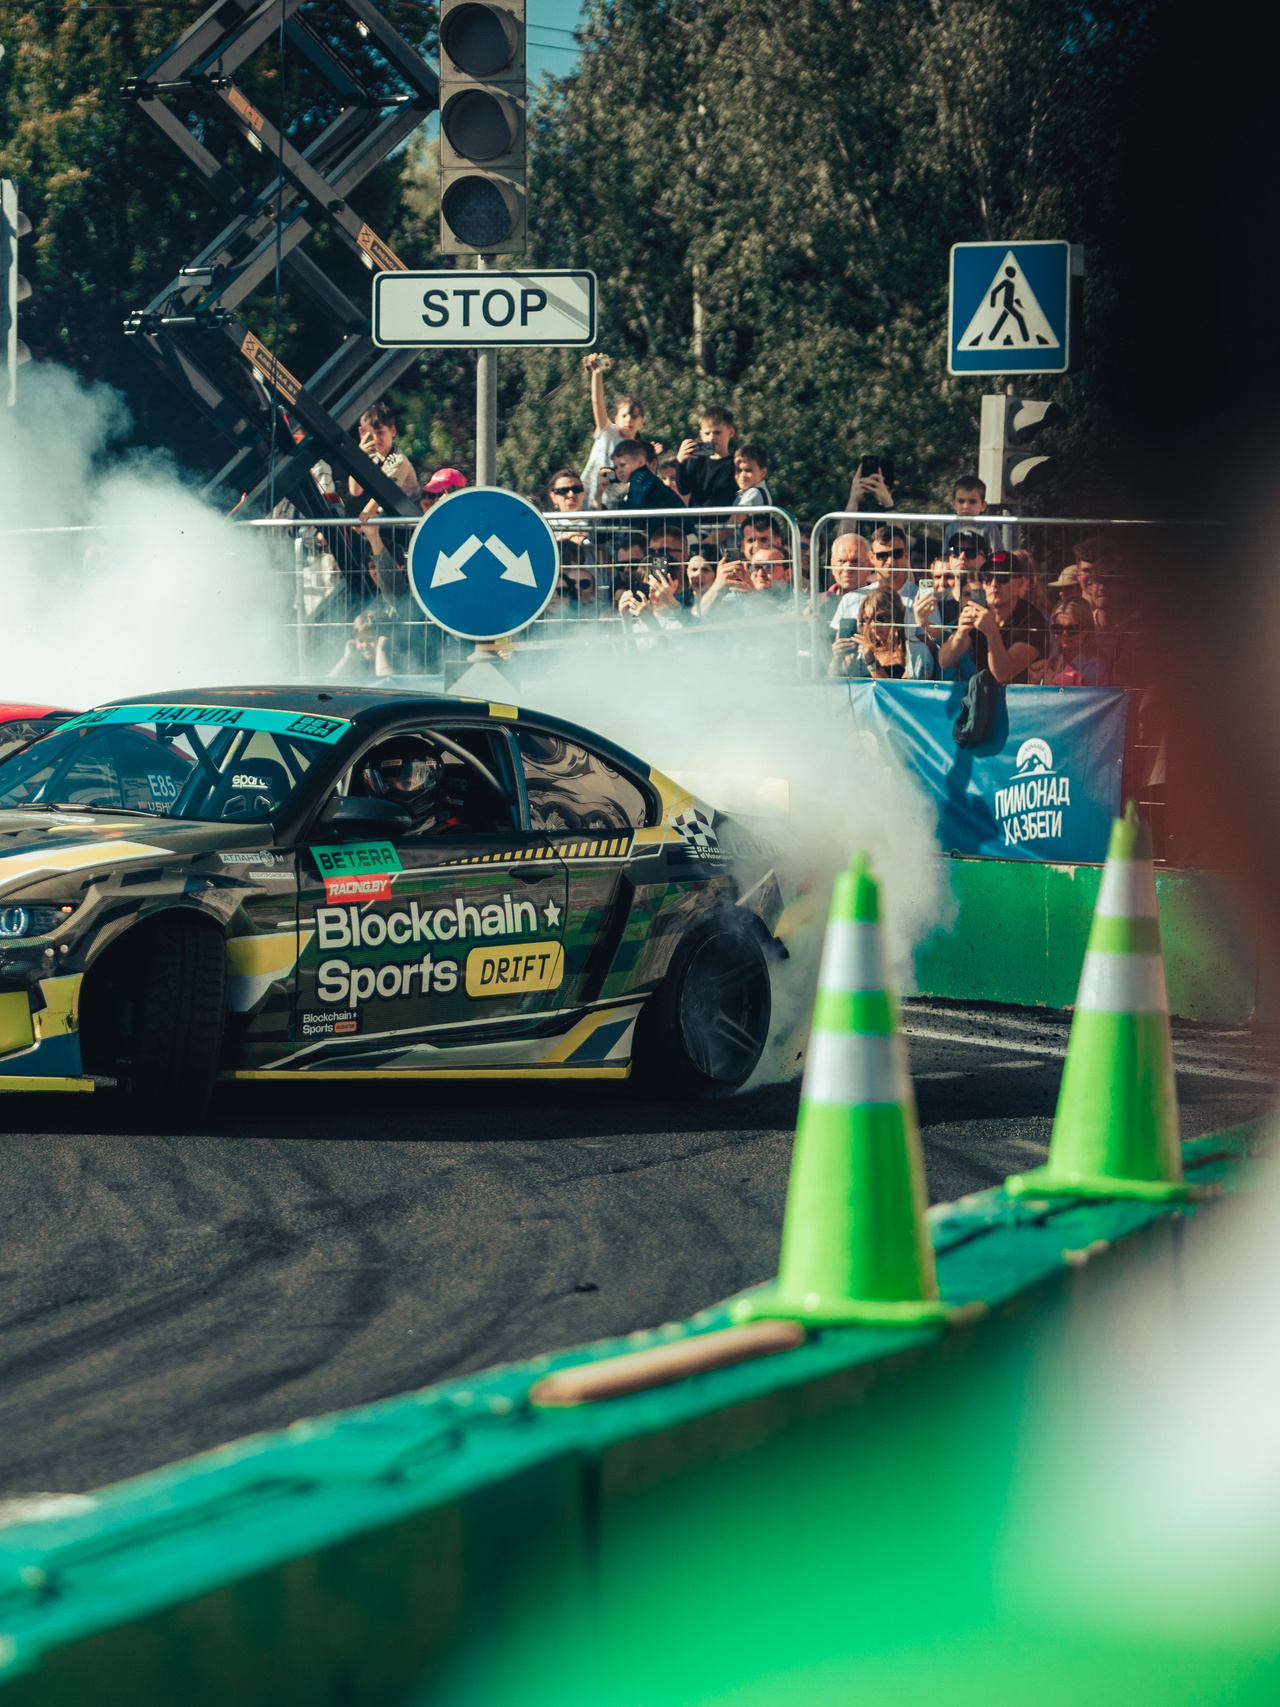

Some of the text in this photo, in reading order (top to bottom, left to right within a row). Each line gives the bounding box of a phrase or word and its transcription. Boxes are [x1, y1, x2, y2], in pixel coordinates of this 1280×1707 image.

[422, 289, 548, 328] STOP
[300, 716, 338, 729] BET
[147, 774, 177, 797] E85
[232, 774, 273, 788] sparco
[995, 777, 1070, 820] ЛИМОНАД
[1003, 810, 1062, 846] КАЗБЕГИ
[223, 854, 259, 862] АТЛАНТ
[329, 879, 388, 896] RACING.BY
[317, 894, 538, 949] Blockchain
[317, 952, 551, 1008] Sports DRIFT
[303, 1011, 352, 1023] Blockchain
[302, 1024, 334, 1036] Sports
